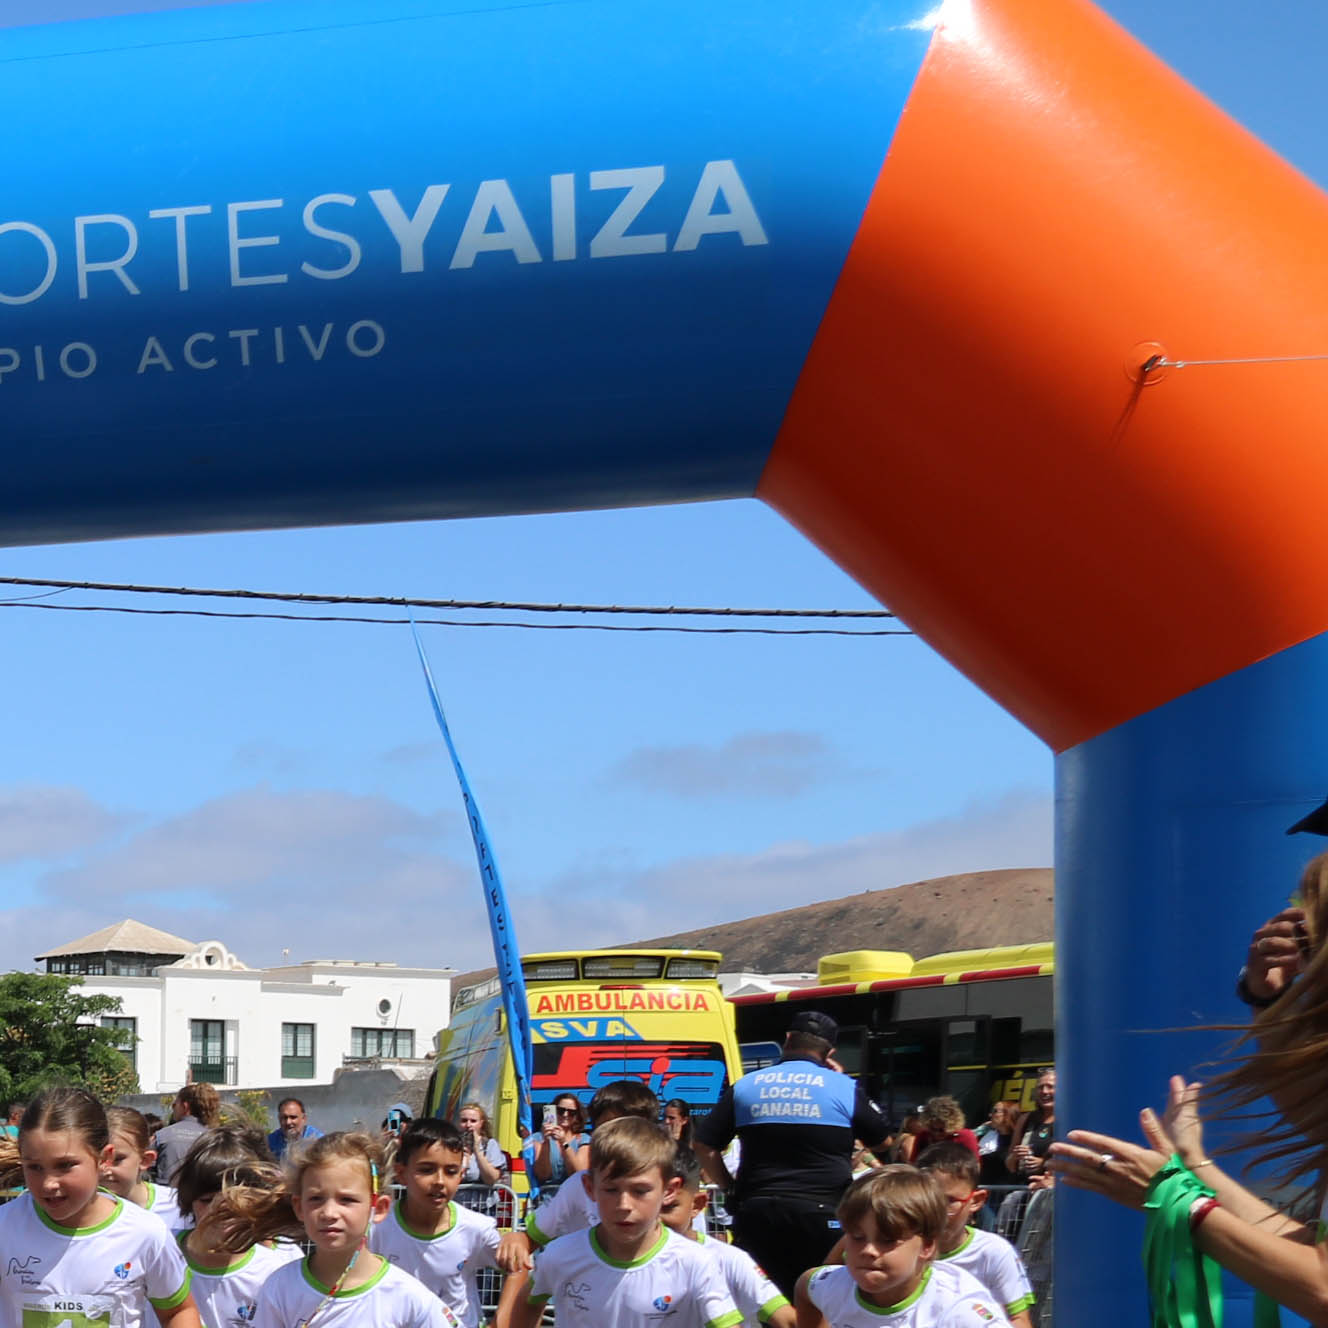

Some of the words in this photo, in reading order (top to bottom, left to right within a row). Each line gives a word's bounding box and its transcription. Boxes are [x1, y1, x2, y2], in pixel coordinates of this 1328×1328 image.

[136, 318, 388, 377] ACTIVO
[536, 991, 709, 1013] AMBULANCIA
[754, 1071, 824, 1088] POLICIA
[759, 1086, 812, 1101] LOCAL
[750, 1103, 822, 1120] CANARIA
[54, 1302, 83, 1311] KIDS
